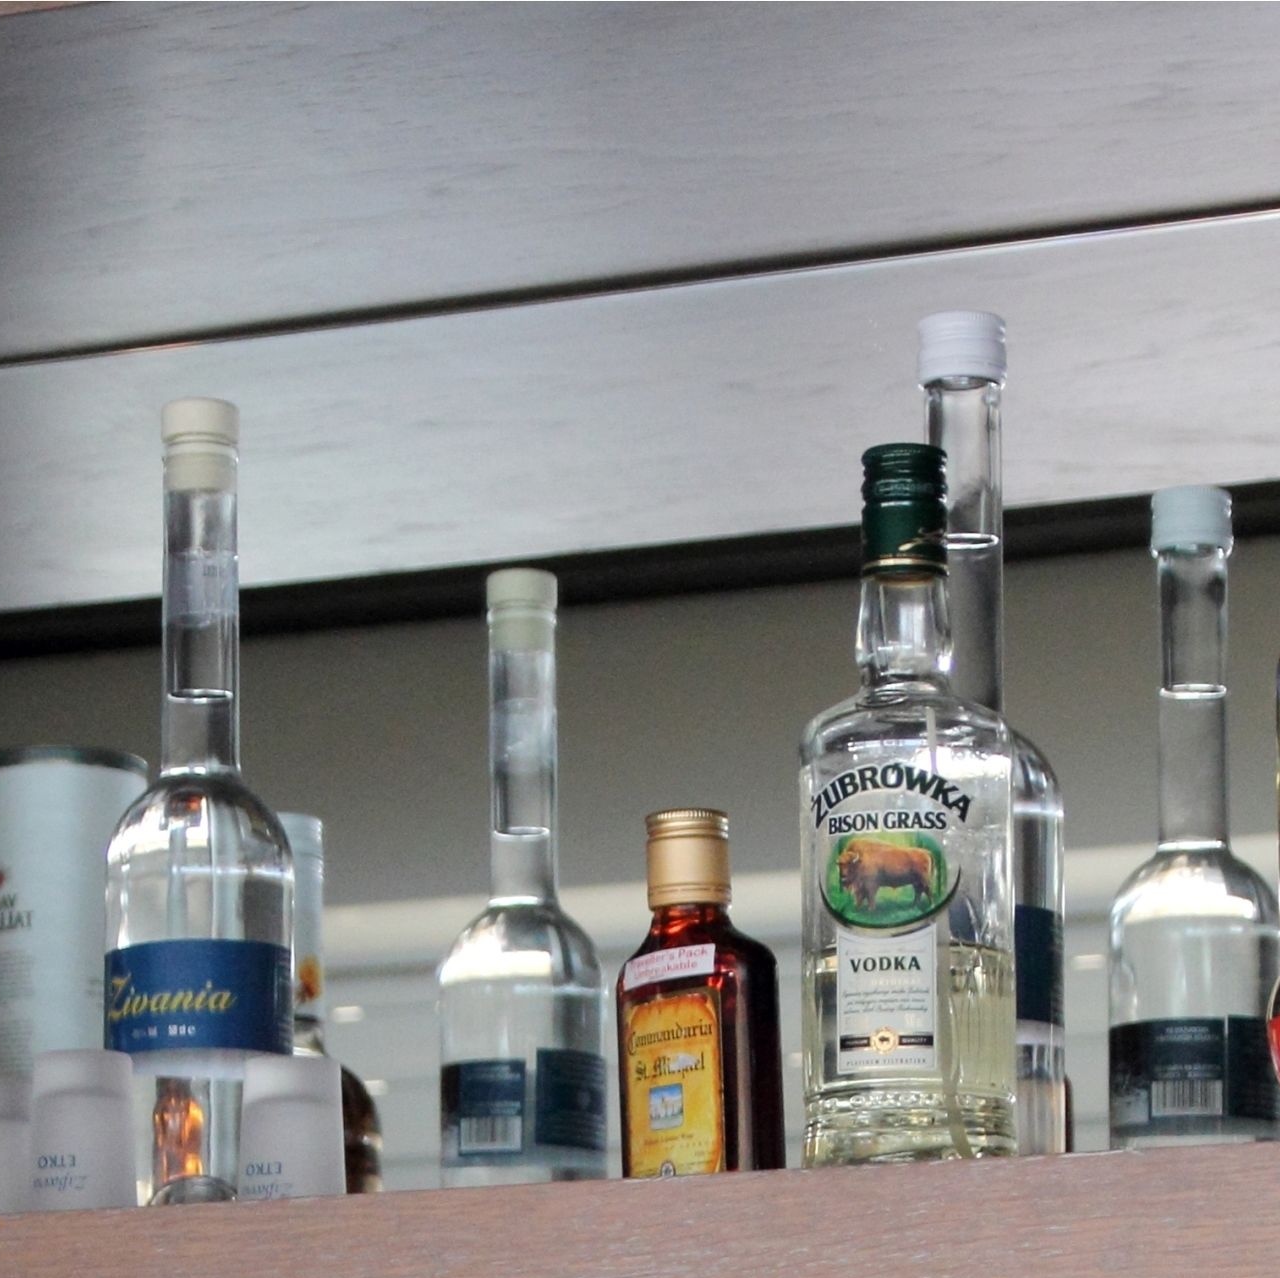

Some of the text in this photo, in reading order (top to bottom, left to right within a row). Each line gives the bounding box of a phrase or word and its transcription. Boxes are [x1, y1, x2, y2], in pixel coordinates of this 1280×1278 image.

[829, 811, 947, 834] BISON GRASS
[850, 955, 922, 974] VODKA
[107, 970, 236, 1022] Zivania
